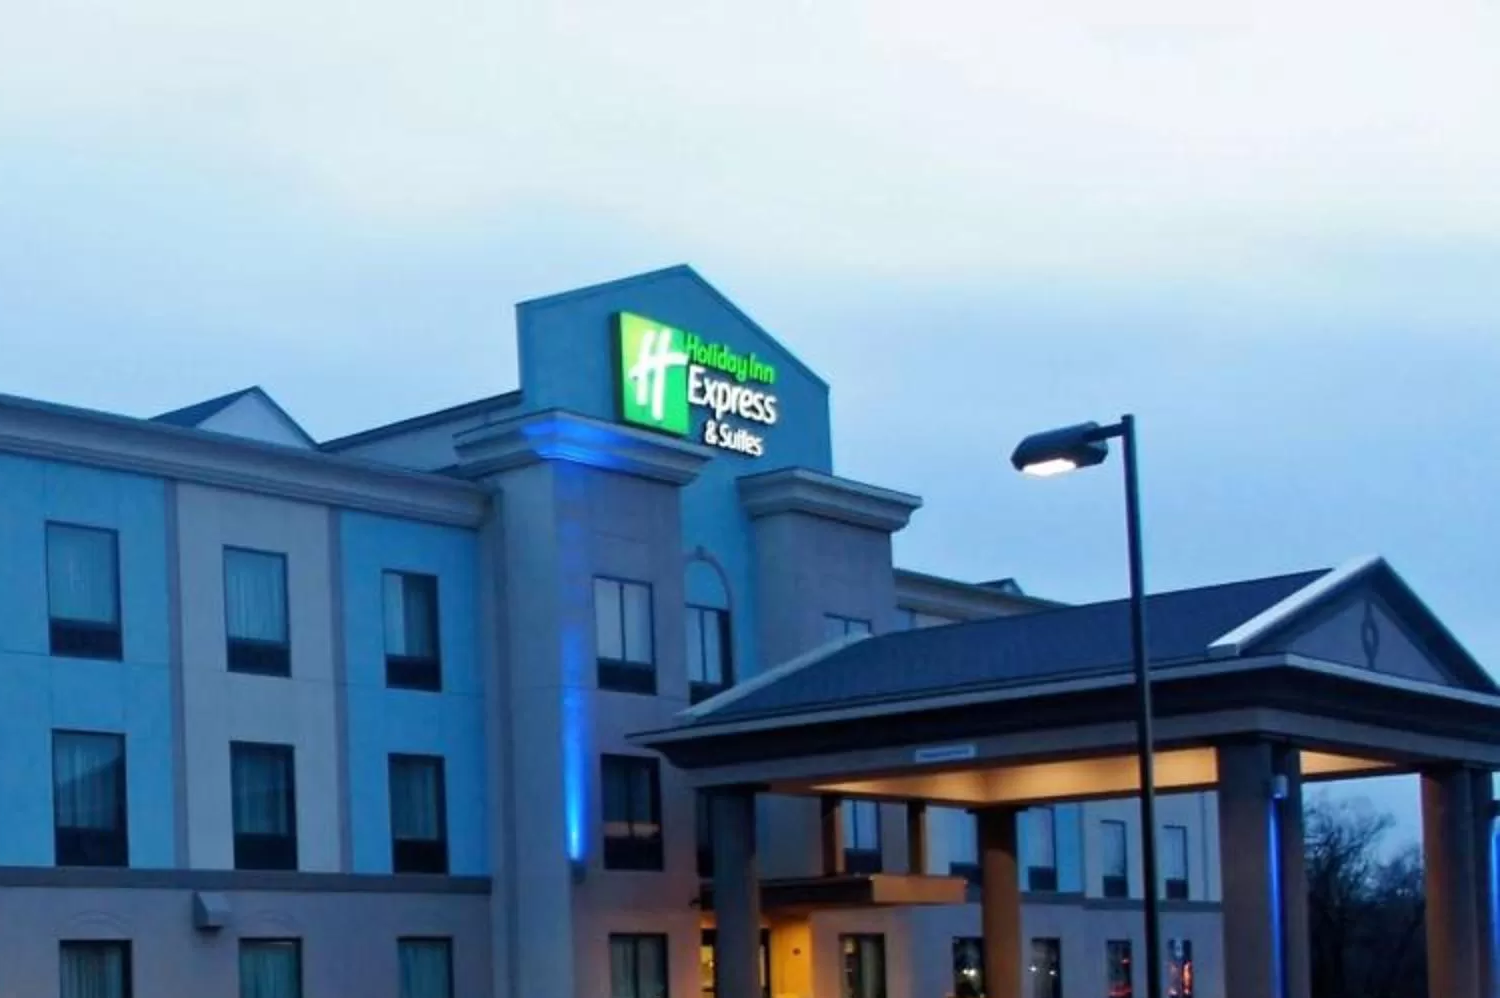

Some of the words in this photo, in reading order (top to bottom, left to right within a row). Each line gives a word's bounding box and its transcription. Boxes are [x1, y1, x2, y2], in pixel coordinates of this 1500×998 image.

[686, 333, 748, 382] Holiday
[749, 351, 775, 385] Inn
[688, 364, 777, 425] Express
[705, 420, 718, 445] &
[718, 423, 764, 457] Suites
